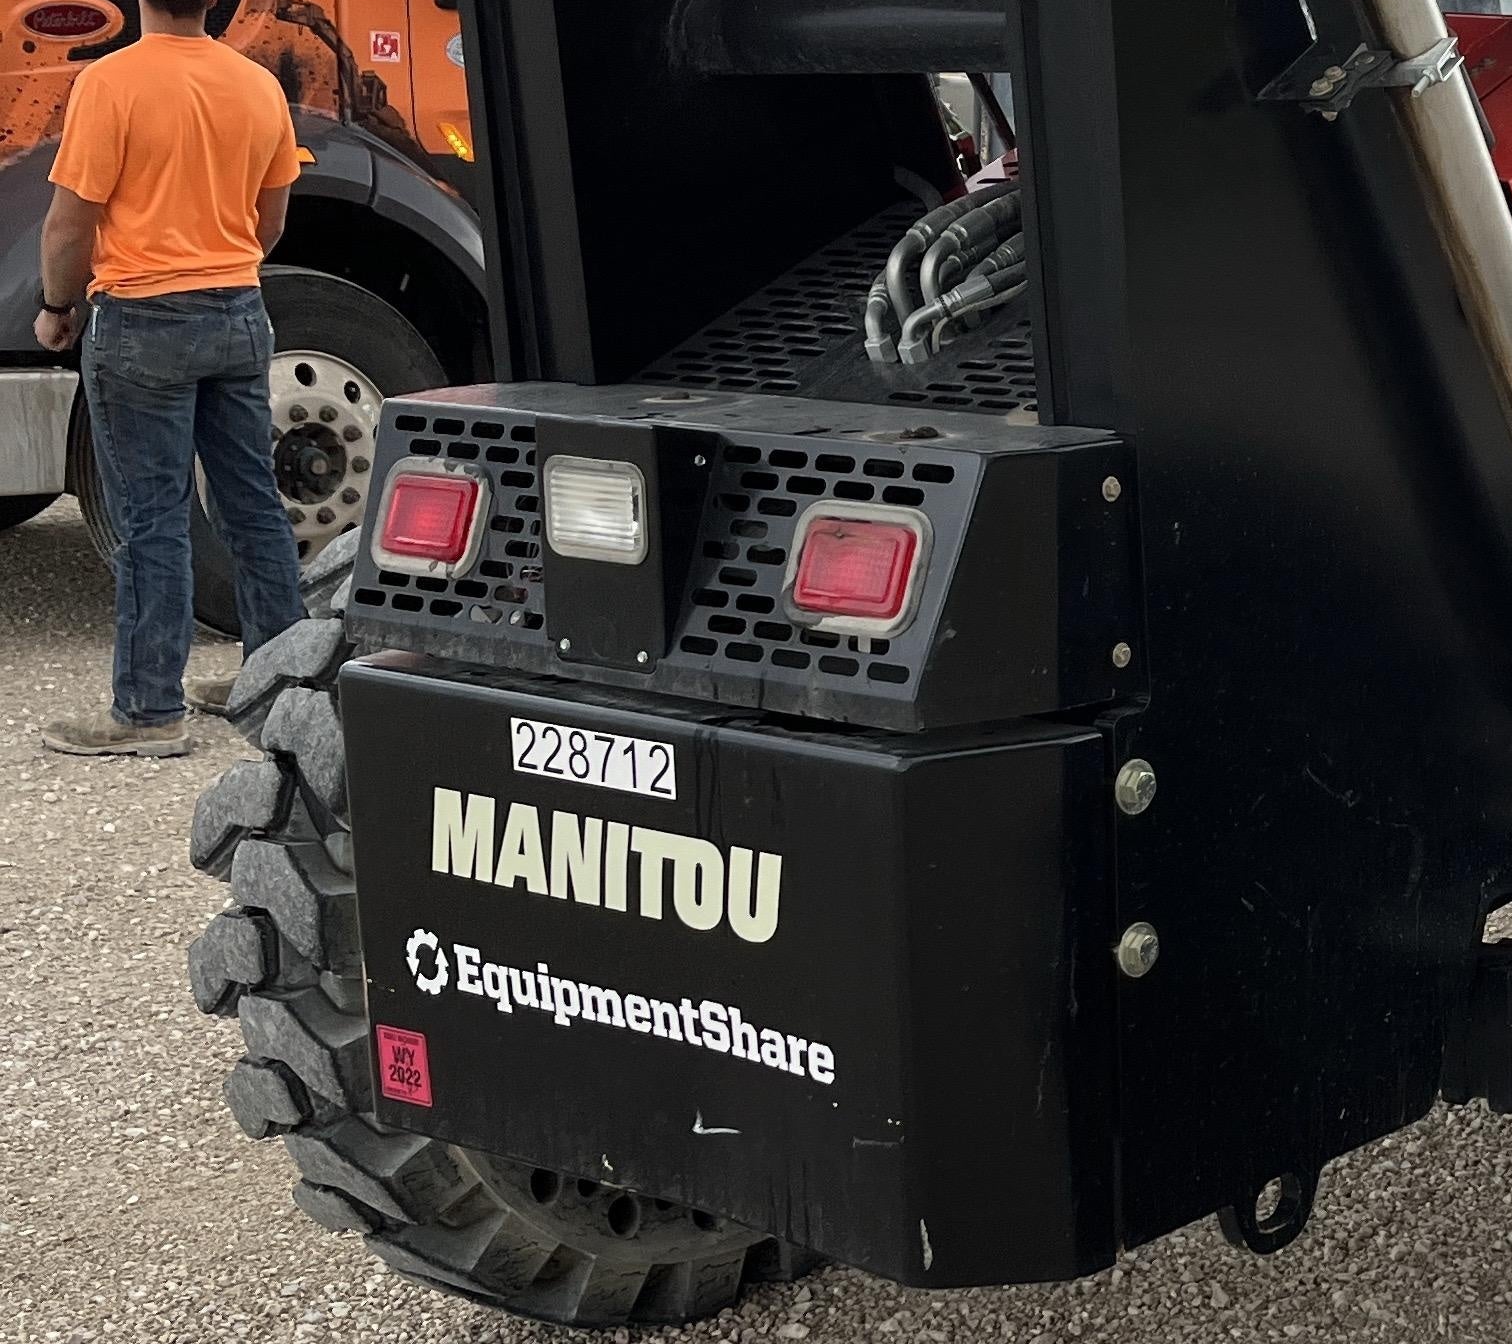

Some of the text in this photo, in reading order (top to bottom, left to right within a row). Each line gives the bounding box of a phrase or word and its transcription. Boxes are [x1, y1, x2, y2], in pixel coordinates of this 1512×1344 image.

[515, 720, 673, 795] 228712
[432, 786, 782, 943] MANITOU
[453, 943, 835, 1085] EquipmentShare
[388, 1064, 422, 1088] 2022
[391, 1045, 415, 1066] WY
